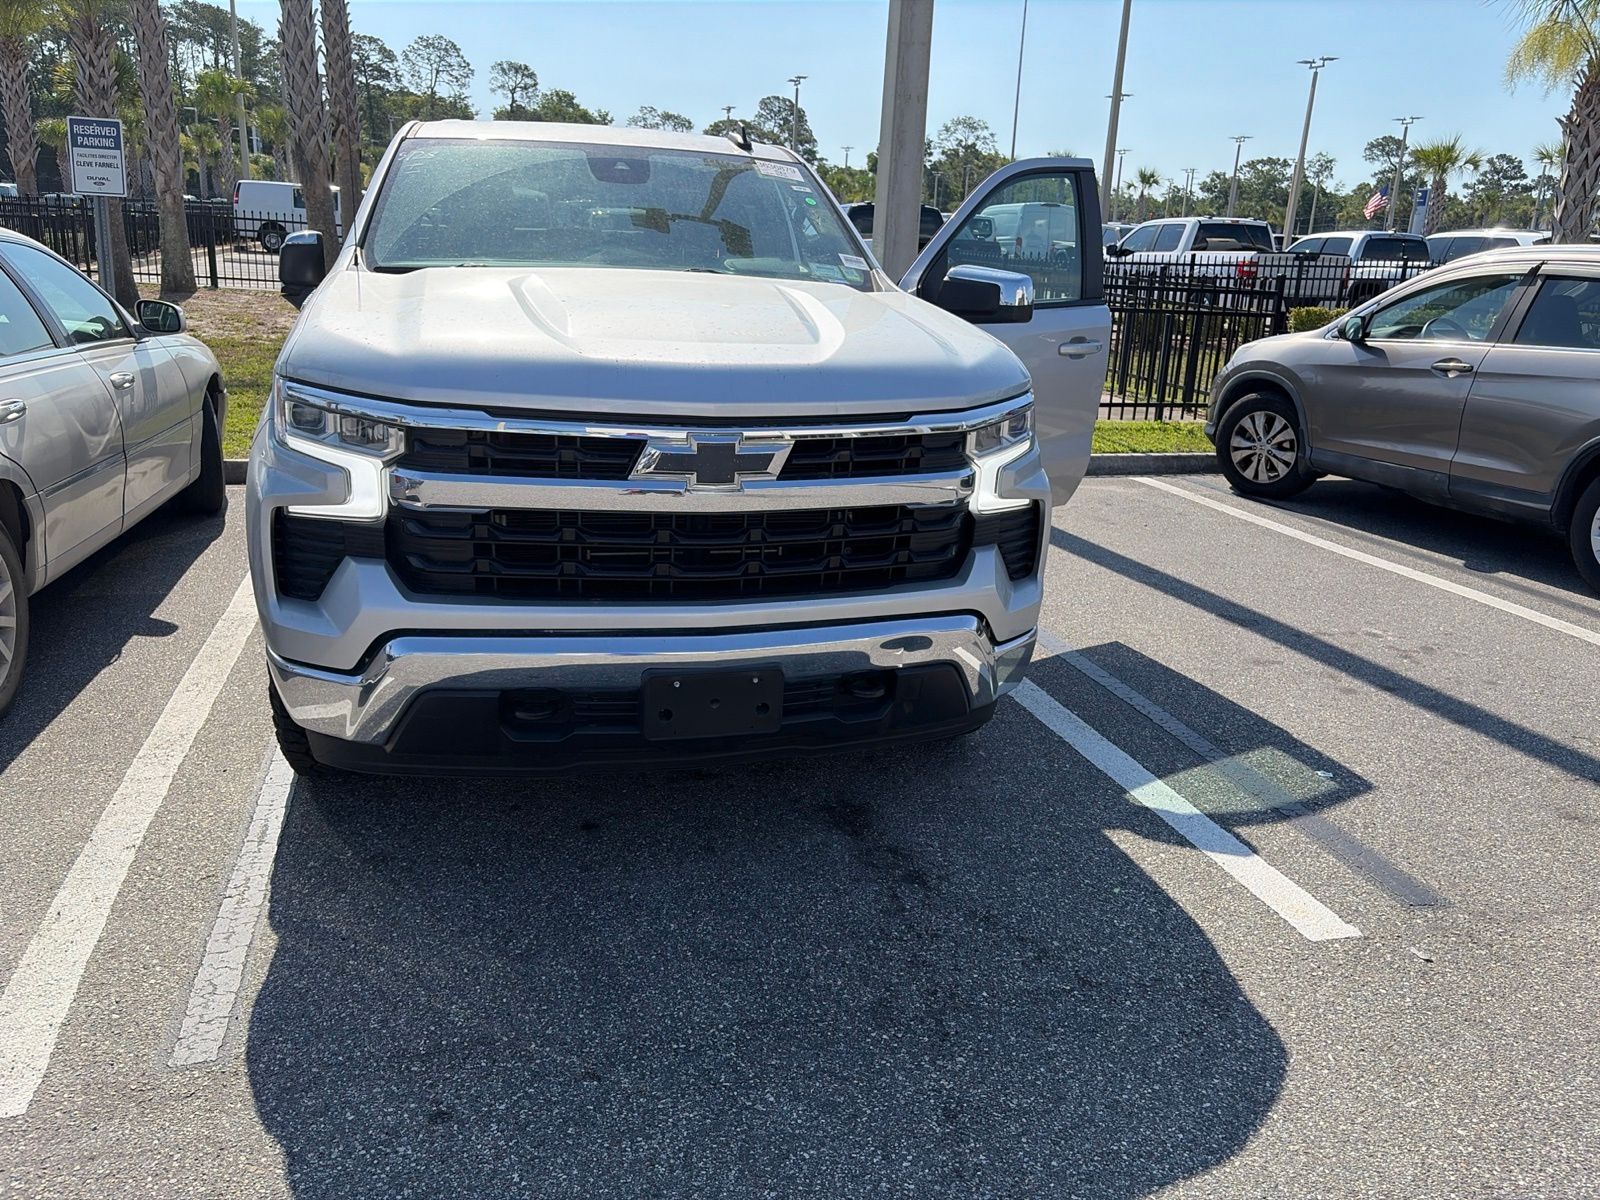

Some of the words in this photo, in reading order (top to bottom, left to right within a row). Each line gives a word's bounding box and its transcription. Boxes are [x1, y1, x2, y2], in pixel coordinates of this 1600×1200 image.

[73, 125, 117, 136] RESERVED
[77, 136, 115, 147] PARKING
[95, 161, 119, 169] FARNELL
